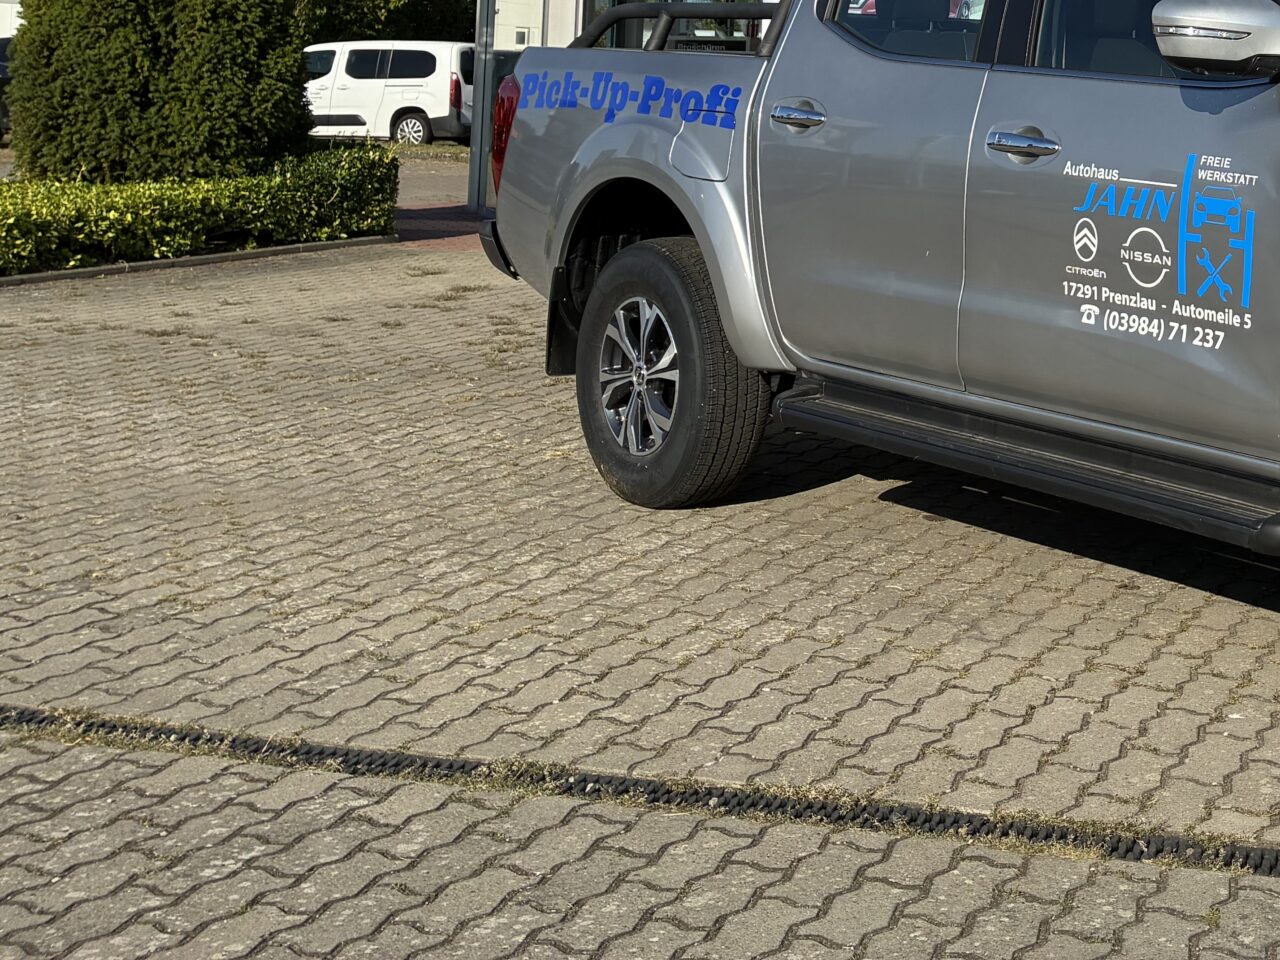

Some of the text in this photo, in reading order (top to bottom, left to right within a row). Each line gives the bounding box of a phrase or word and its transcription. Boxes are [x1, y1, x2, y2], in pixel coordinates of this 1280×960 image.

[518, 71, 742, 130] Pick-Up-Profi
[1063, 161, 1120, 181] Autohaus
[1200, 155, 1232, 169] FREIE
[1198, 169, 1259, 186] WERKSTATT
[1073, 183, 1176, 223] JAHN
[1120, 248, 1172, 267] NISSAN
[1062, 281, 1098, 301] 17291
[1101, 287, 1157, 311] Prenzlau
[1172, 300, 1241, 327] Automeile
[1243, 314, 1252, 329] 5
[1103, 309, 1225, 350] (03984) 71 237
